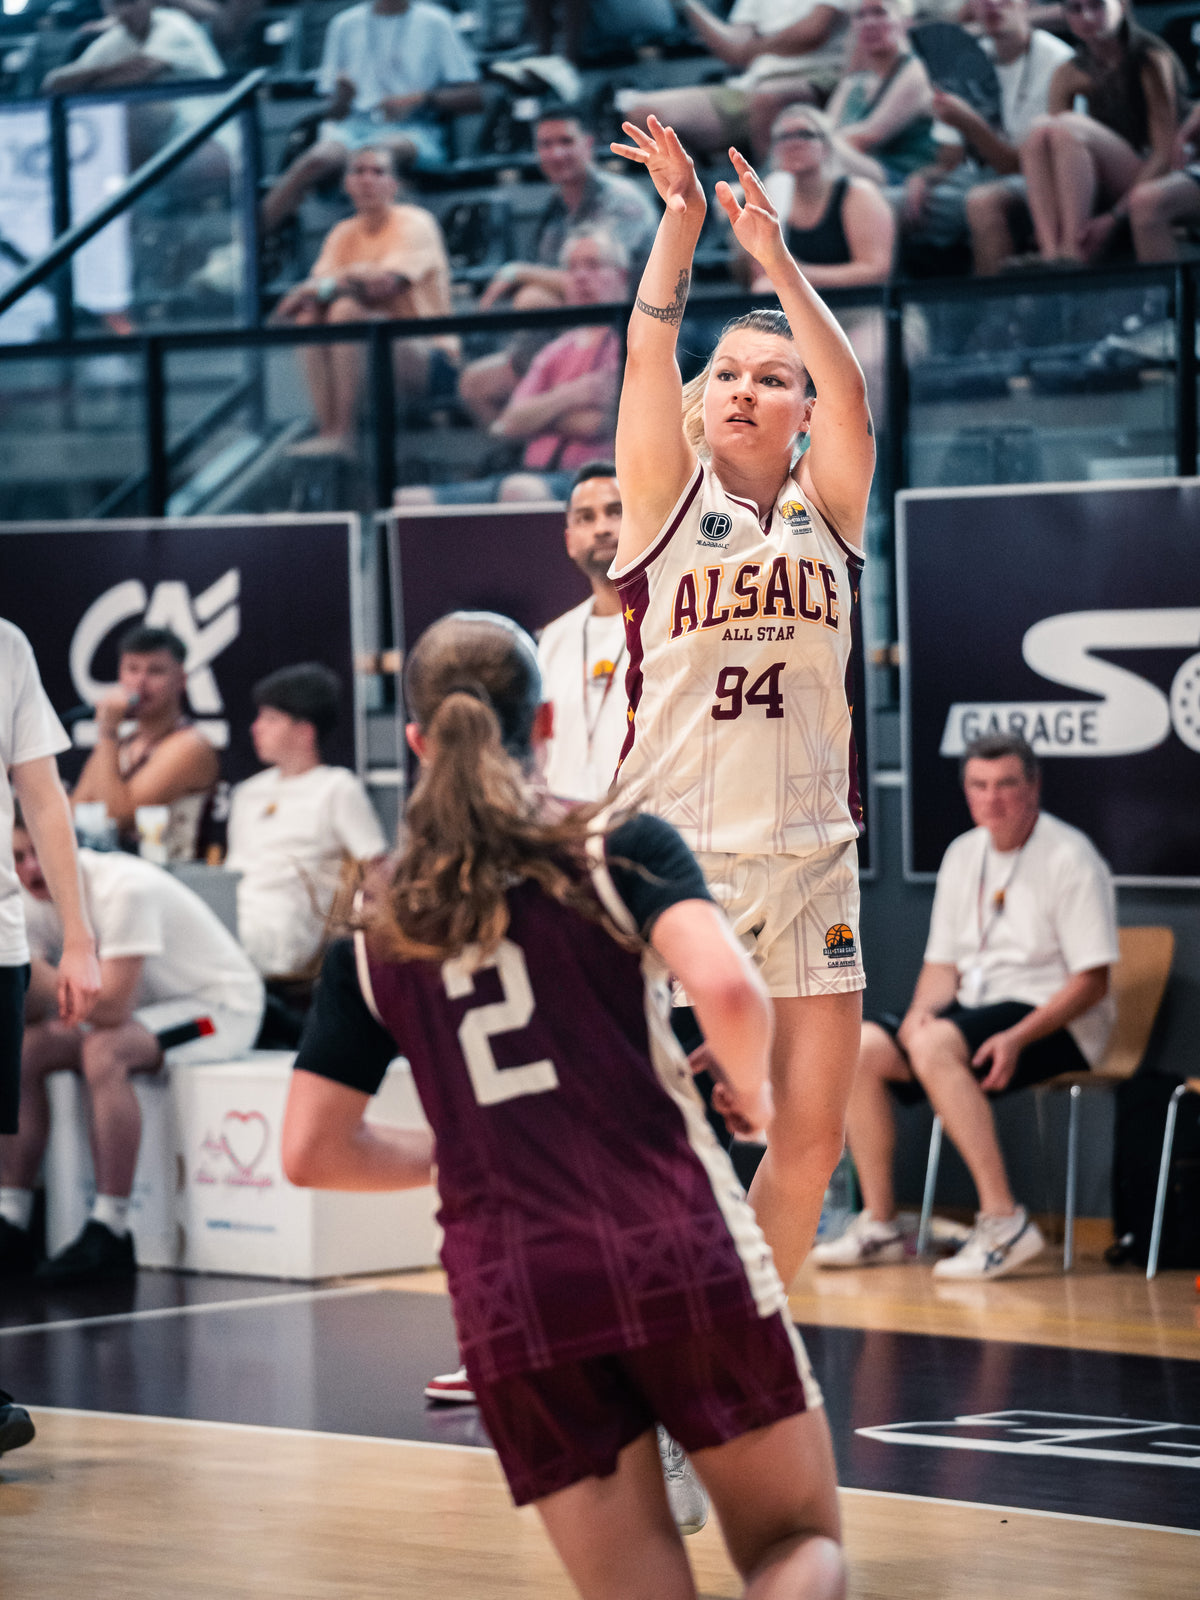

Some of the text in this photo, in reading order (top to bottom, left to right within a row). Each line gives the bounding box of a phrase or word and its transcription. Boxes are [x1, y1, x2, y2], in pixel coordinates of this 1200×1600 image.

[668, 553, 840, 642] ALSACE
[722, 626, 795, 641] ALL STAR
[711, 662, 786, 720] 94
[961, 710, 1098, 745] GARAGE
[441, 938, 560, 1107] 2
